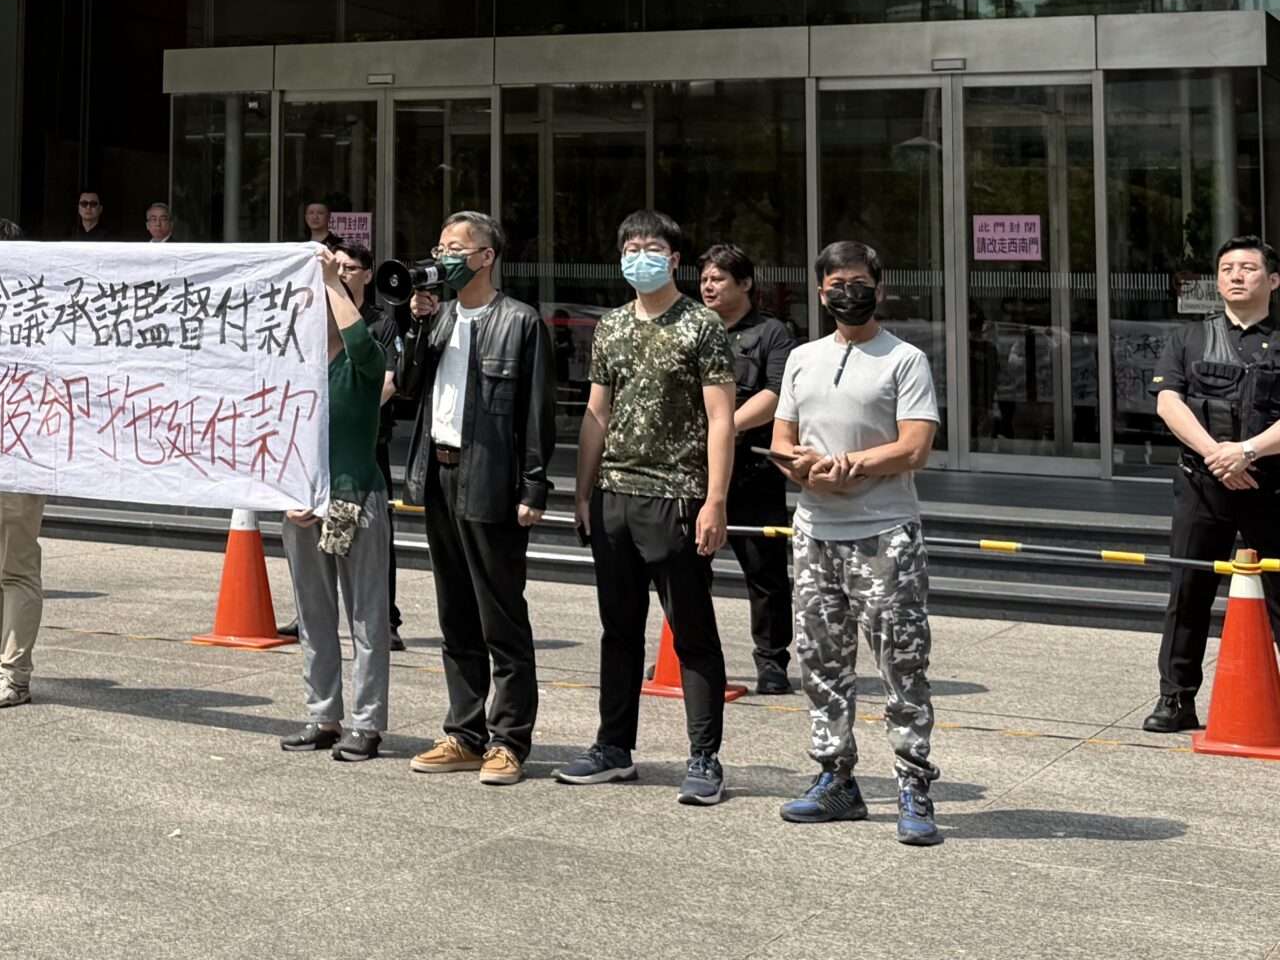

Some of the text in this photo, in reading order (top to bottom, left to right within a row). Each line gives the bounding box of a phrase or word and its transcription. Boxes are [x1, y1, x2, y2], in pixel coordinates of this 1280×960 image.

[977, 220, 1037, 234] 此門封閉
[976, 236, 1039, 255] 請改走西南門
